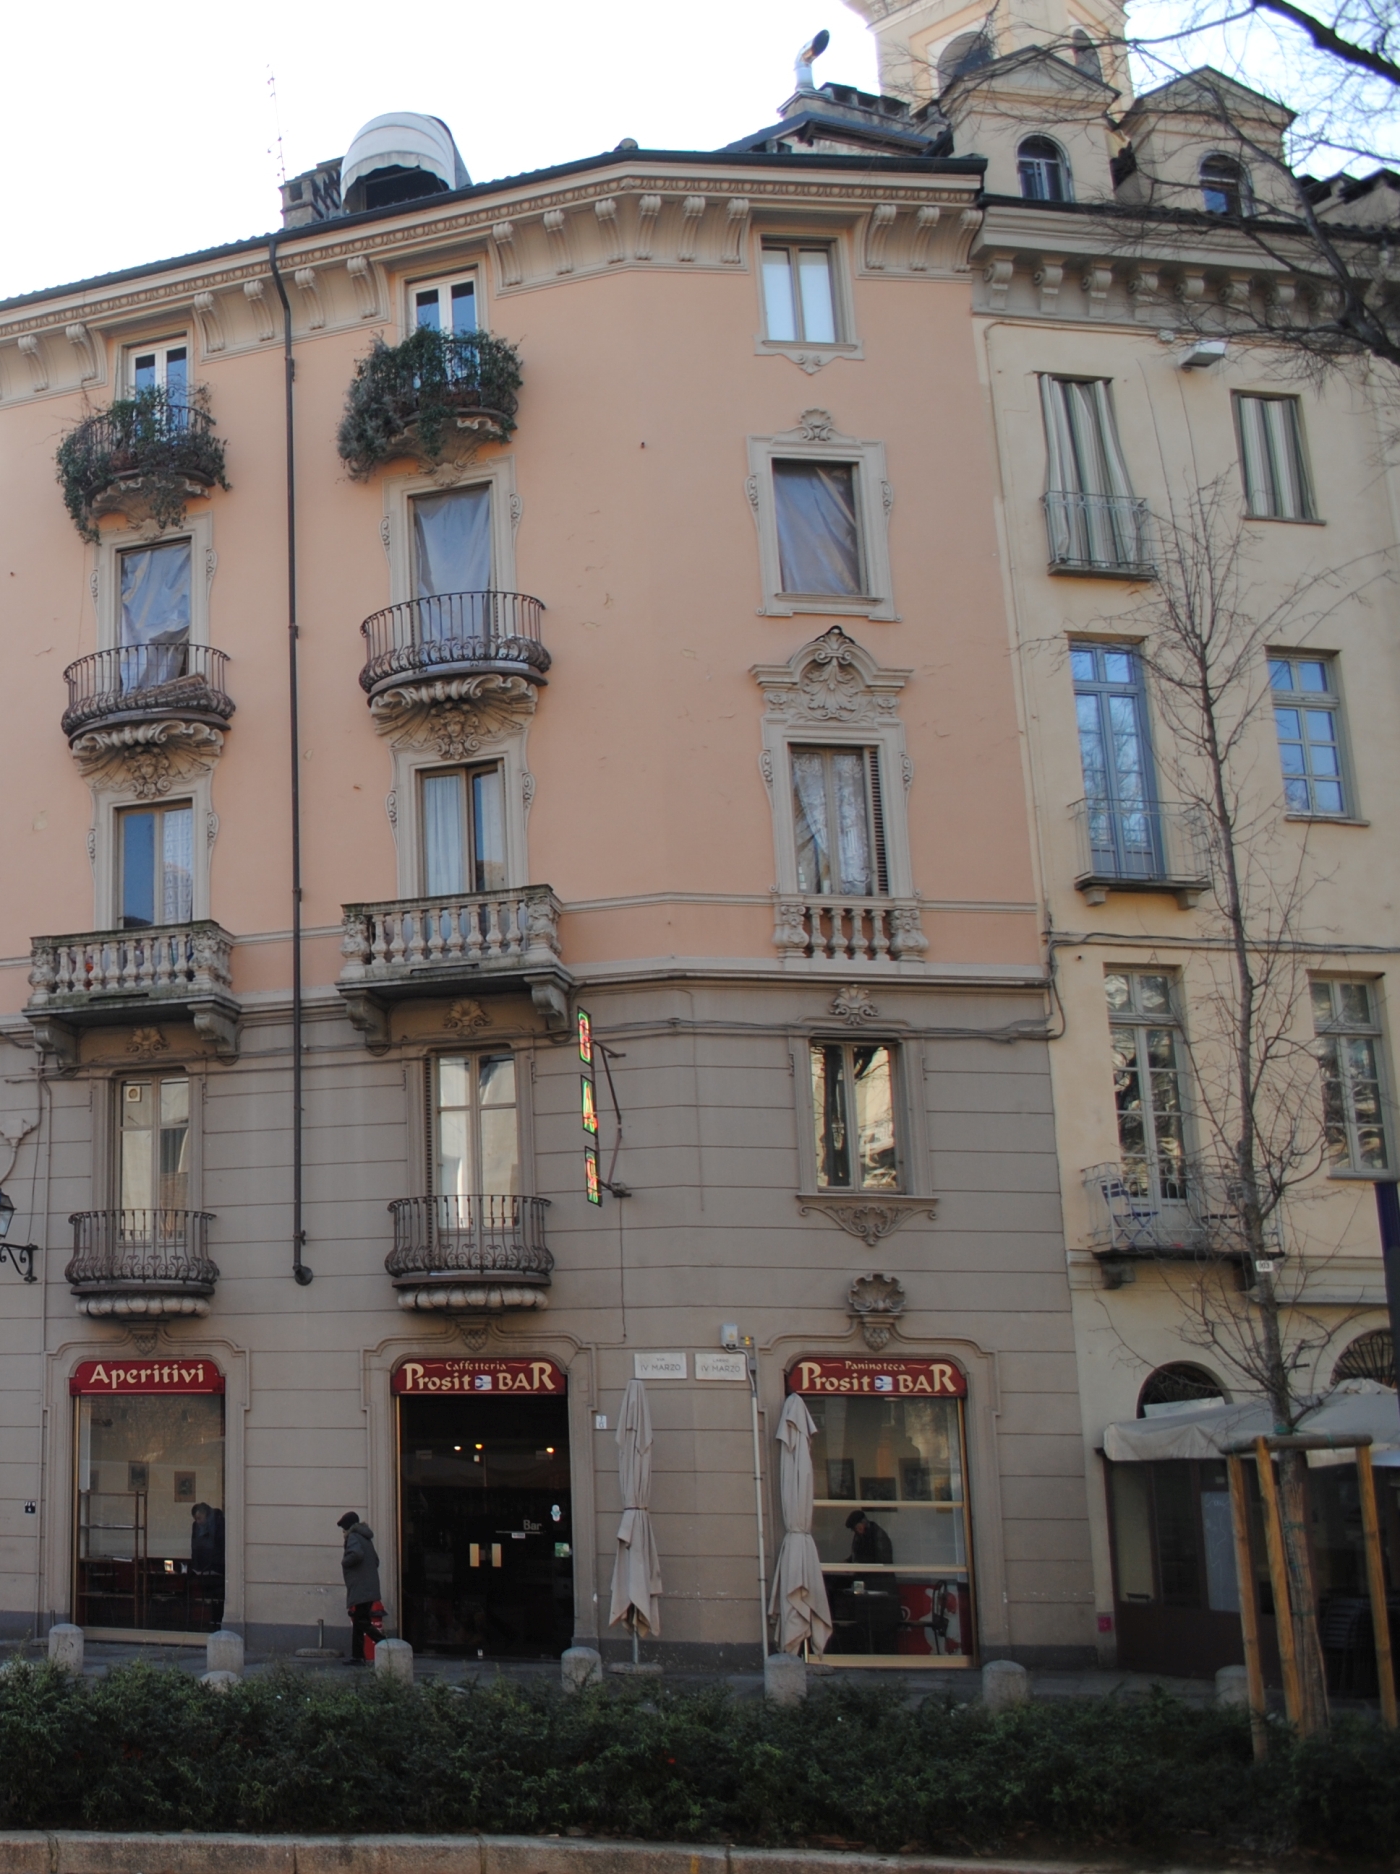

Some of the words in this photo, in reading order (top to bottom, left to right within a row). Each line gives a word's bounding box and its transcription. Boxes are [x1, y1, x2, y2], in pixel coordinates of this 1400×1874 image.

[445, 1361, 507, 1371] Caffetteria
[640, 1364, 649, 1372] IV
[651, 1363, 682, 1371] MARZO
[712, 1365, 741, 1373] MARZO
[844, 1360, 906, 1371] Paninoteca
[89, 1363, 205, 1389] Aperitivi
[402, 1362, 472, 1391] Prosit
[496, 1361, 556, 1391] BAR
[797, 1361, 871, 1392] Prosit
[896, 1363, 957, 1393] BAR
[522, 1519, 542, 1531] Bar
